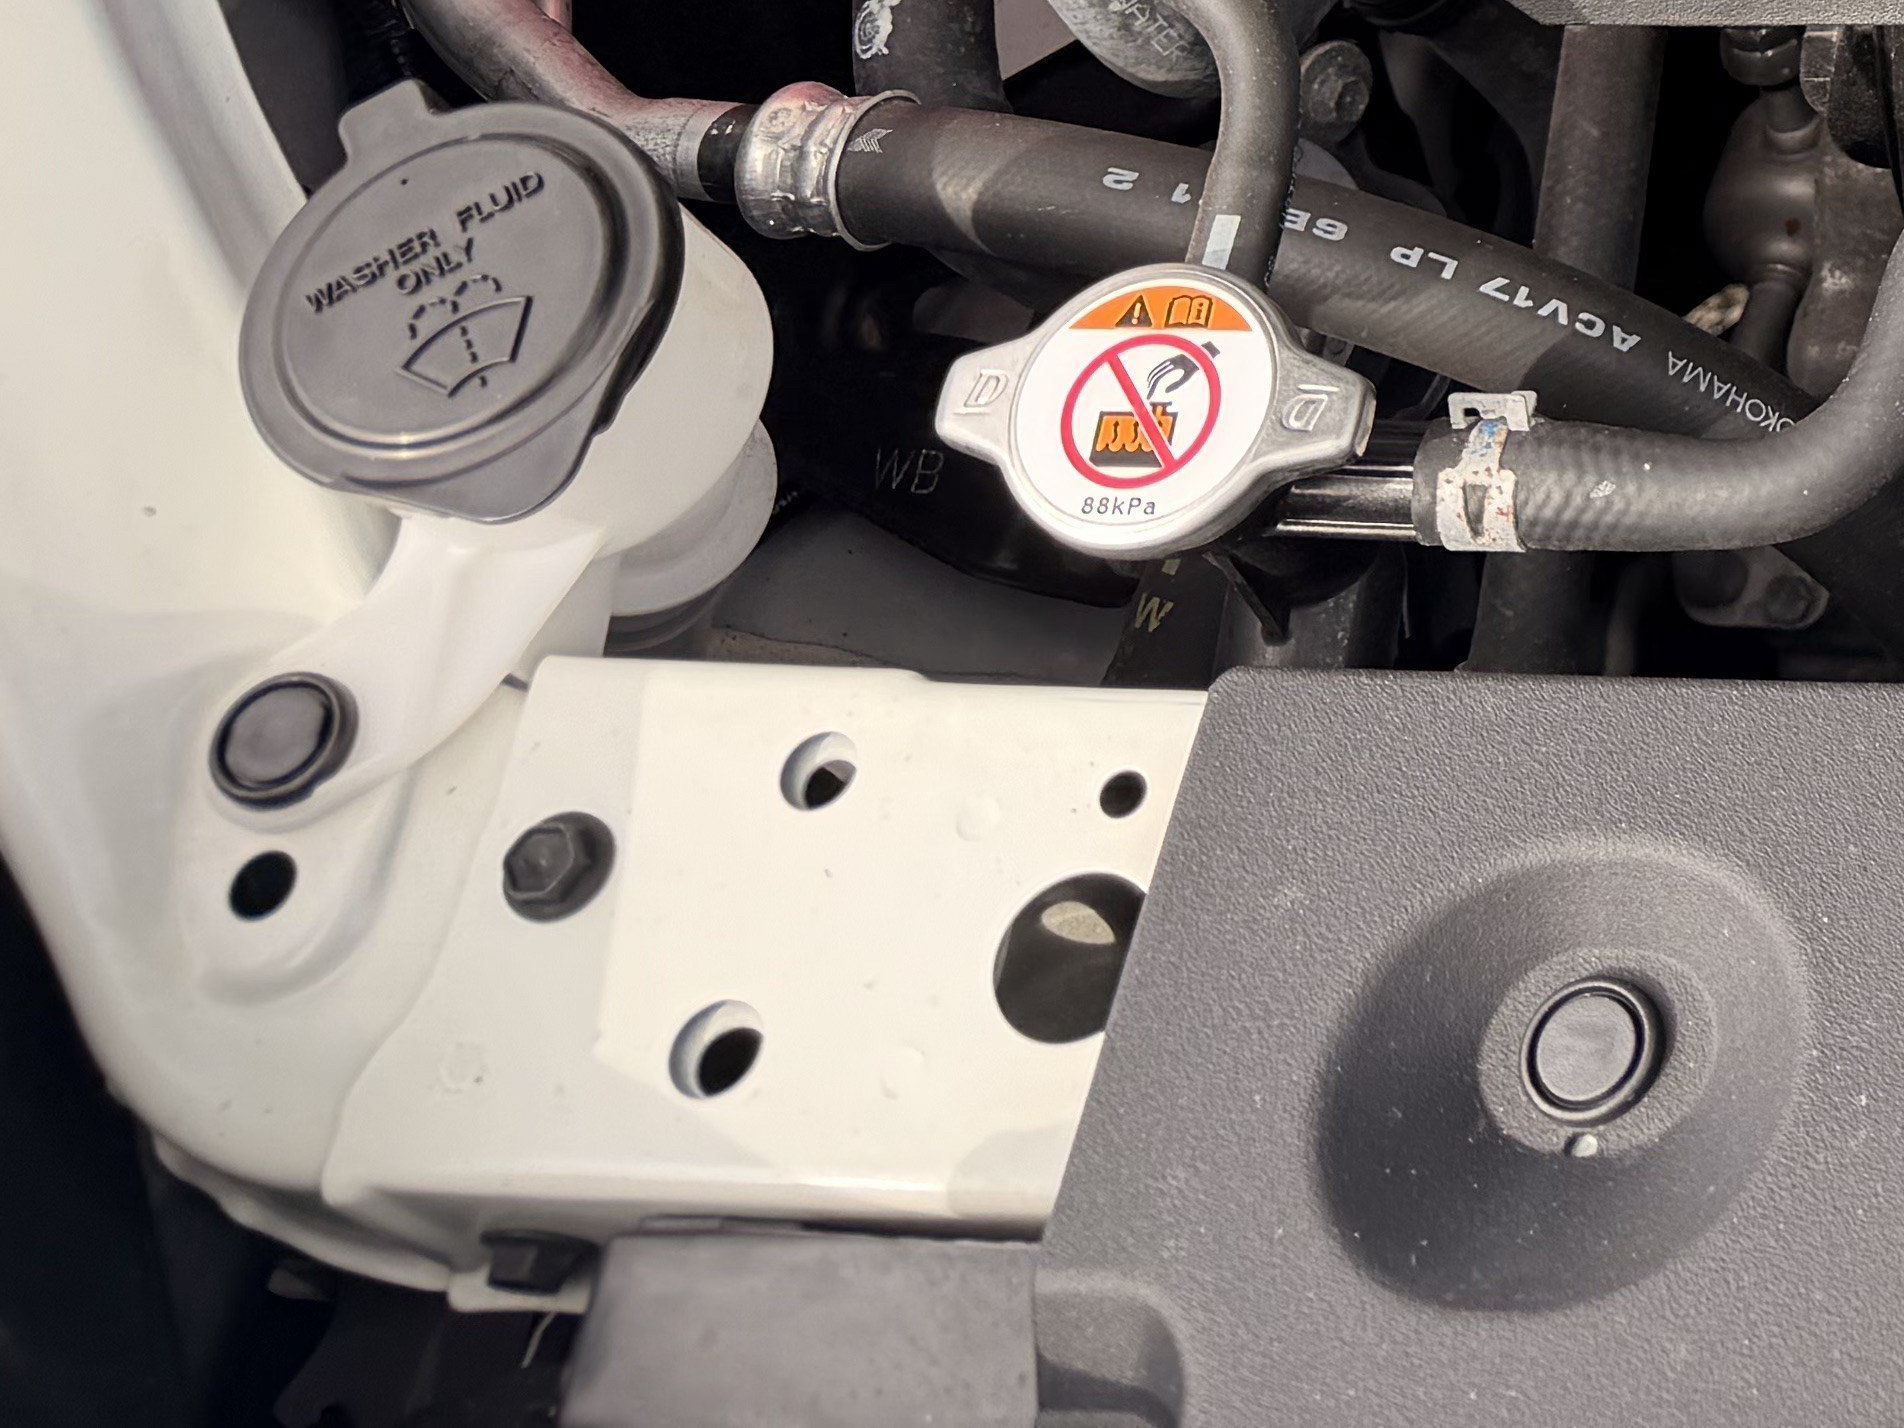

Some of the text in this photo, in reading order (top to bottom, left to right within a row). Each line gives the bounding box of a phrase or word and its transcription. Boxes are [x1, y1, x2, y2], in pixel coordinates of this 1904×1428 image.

[305, 170, 546, 314] WASHER FLUID
[396, 235, 475, 296] ONLY
[1389, 245, 1460, 280] LP
[1478, 275, 1643, 353] ACV17
[1080, 494, 1158, 520] 88kPa
